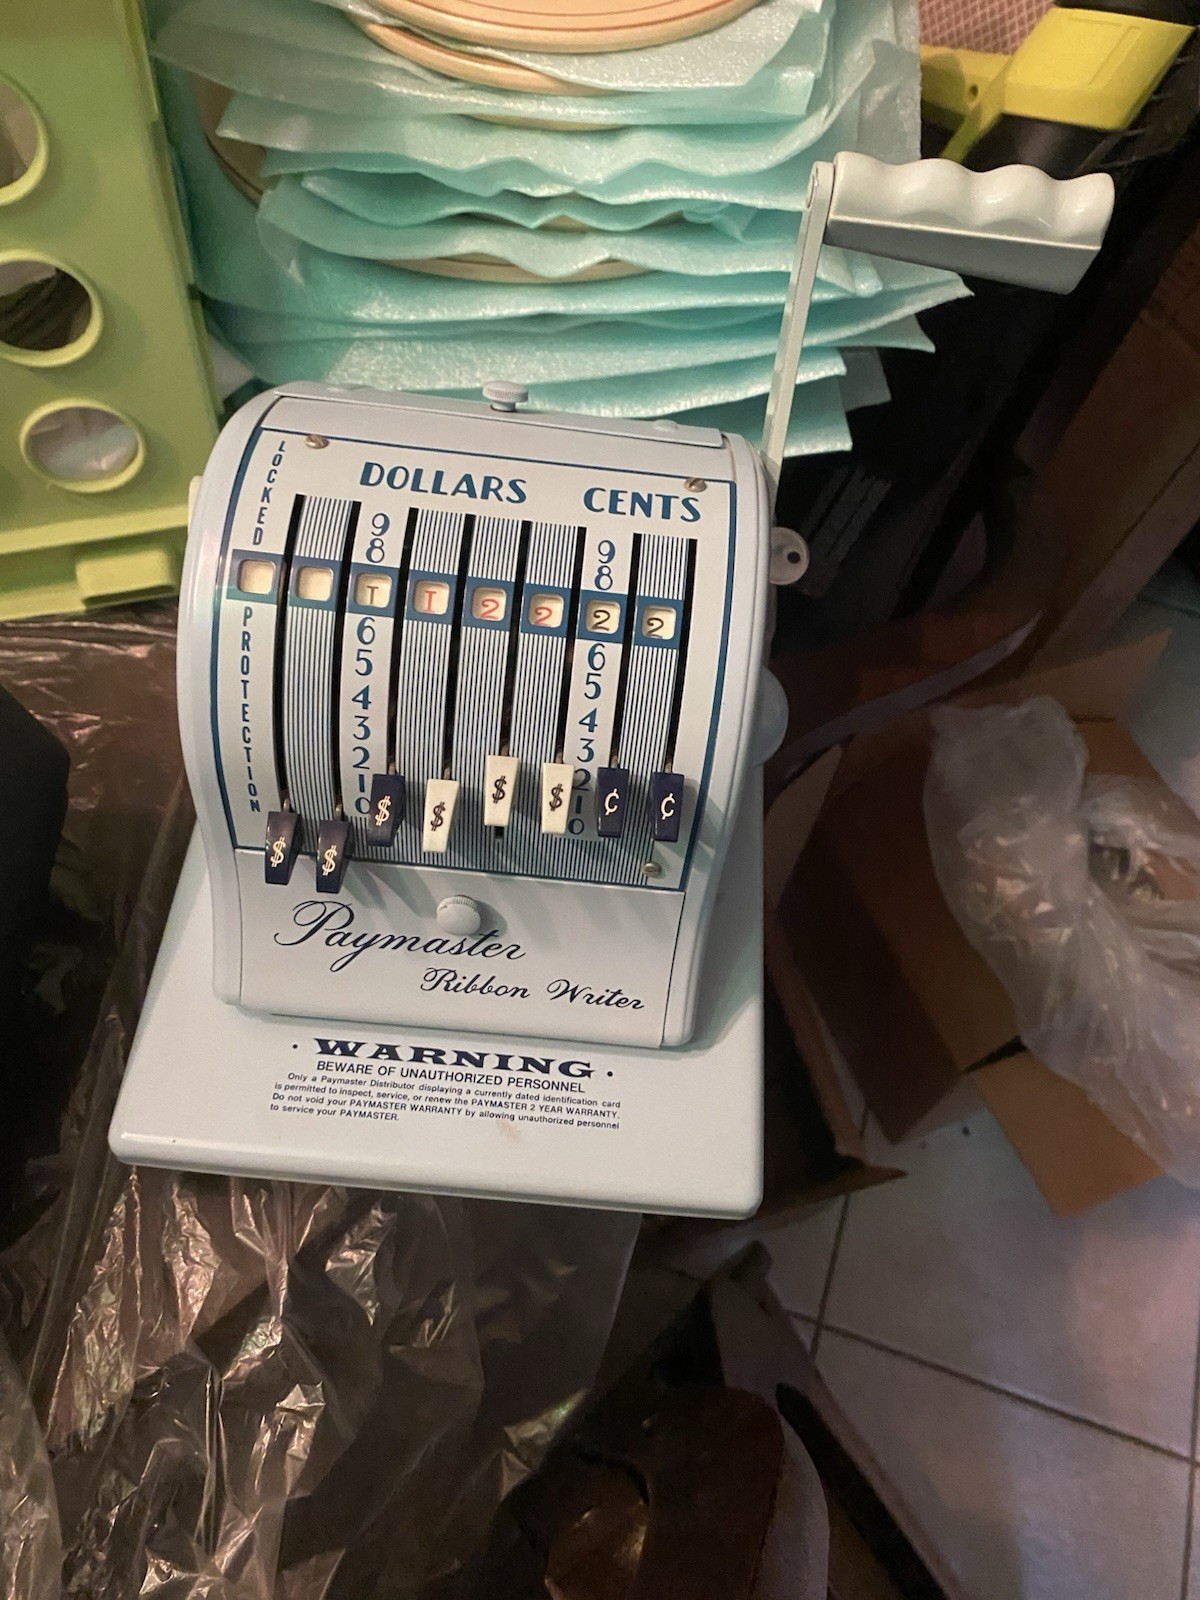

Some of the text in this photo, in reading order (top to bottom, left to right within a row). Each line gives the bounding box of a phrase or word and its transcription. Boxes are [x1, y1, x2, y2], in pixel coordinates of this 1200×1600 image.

[252, 441, 285, 545] LOCKED
[360, 461, 527, 504] DOLLARS
[583, 487, 702, 523] CENTS
[365, 512, 390, 563] 9 8
[594, 539, 616, 590] 9 8
[357, 616, 376, 645] 6
[481, 598, 499, 619] 2
[592, 609, 611, 632] 2
[646, 617, 664, 637] 2
[355, 649, 373, 676] 5
[240, 606, 261, 813] PROTECTION
[351, 685, 372, 710] 4
[352, 715, 371, 741] 3
[568, 643, 606, 835] 6 5 4 3 2 1 0
[352, 746, 370, 770] 2
[357, 773, 365, 793] 1
[273, 900, 526, 973] Paymaster
[420, 967, 645, 1010] Ribbon Writer
[313, 1037, 596, 1079] WARNING
[316, 1060, 585, 1094] BEWARE OF UNAUTHORIZED PERSONNEL
[274, 1082, 282, 1090] is
[283, 1083, 327, 1094] permitted
[328, 1087, 338, 1095] to
[339, 1087, 374, 1099] inspect,
[376, 1091, 411, 1101] service,
[424, 1096, 453, 1104] renew
[454, 1097, 469, 1106] the
[471, 1097, 527, 1112] PAYMASTER
[530, 1103, 536, 1111] 2
[539, 1104, 563, 1114] YEAR
[566, 1107, 621, 1120] WARRANTY.
[287, 1072, 308, 1082] Only
[320, 1075, 367, 1086] Paymaster
[369, 1079, 416, 1090] Distributor
[418, 1083, 463, 1096] displaying
[474, 1088, 513, 1100] currently
[515, 1092, 540, 1101] dated
[543, 1093, 598, 1106] identification
[601, 1100, 621, 1108] card
[270, 1103, 280, 1111] to
[282, 1105, 315, 1114] service
[340, 1108, 399, 1121] PAYMASTER.
[272, 1092, 621, 1130] Do not void your PAYMASTER WARRANTY by allowing unauthorized personnel
